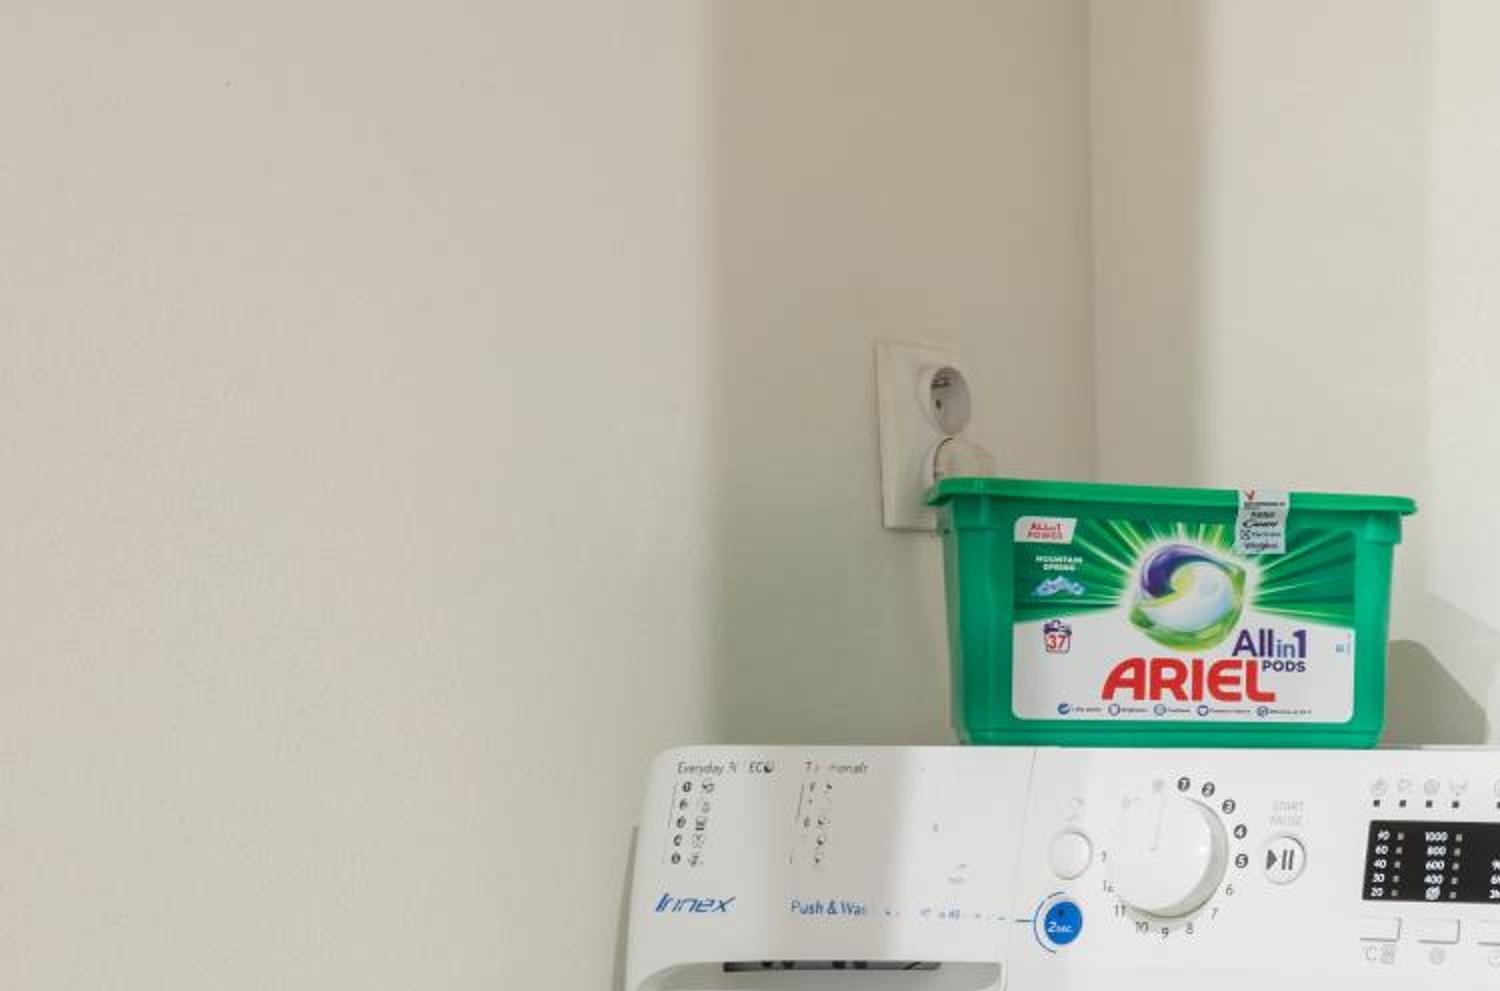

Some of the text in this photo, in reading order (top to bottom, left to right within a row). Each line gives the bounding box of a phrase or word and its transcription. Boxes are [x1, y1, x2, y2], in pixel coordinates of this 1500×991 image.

[1048, 633, 1067, 649] 37
[1262, 660, 1306, 673] PODS
[1101, 656, 1277, 703] ARIEL
[1425, 831, 1448, 842] 1000
[1375, 845, 1388, 855] 60
[1373, 859, 1387, 869] 40
[1424, 874, 1444, 885] 400
[1225, 884, 1234, 896] 6
[655, 892, 736, 913] Innex
[791, 900, 823, 916] Push
[827, 901, 838, 916] &
[1210, 907, 1219, 920] 7
[1161, 927, 1169, 938] 9
[1185, 922, 1194, 934] 8
